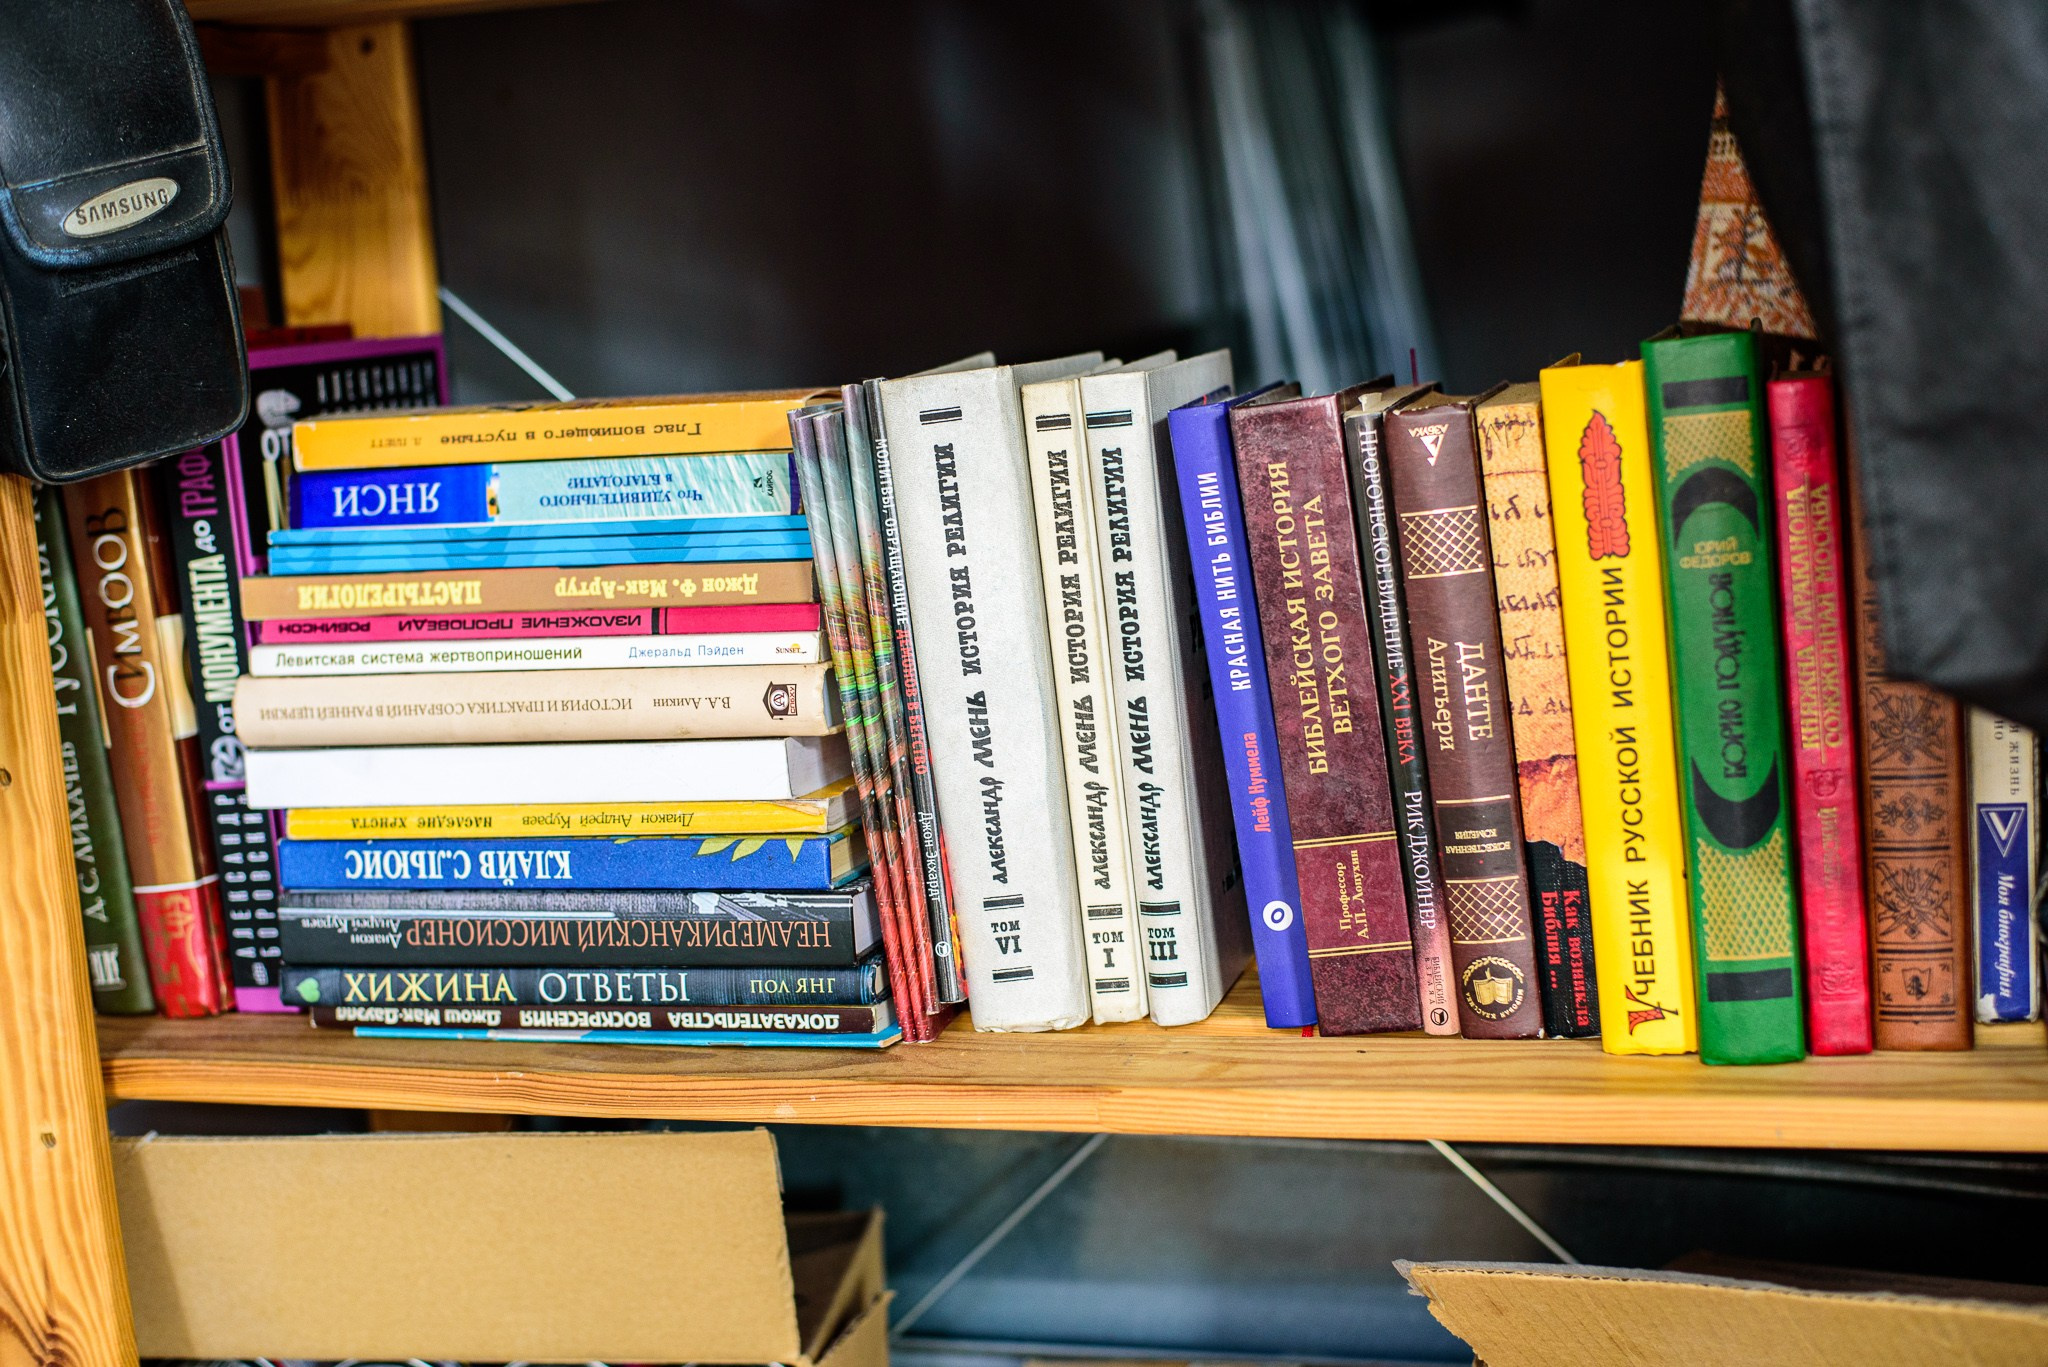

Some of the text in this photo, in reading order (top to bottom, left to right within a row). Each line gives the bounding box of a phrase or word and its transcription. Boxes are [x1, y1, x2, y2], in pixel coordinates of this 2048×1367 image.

[75, 187, 169, 226] SAMSUNG
[441, 431, 517, 445] пустыне
[525, 431, 535, 440] в
[544, 425, 645, 439] вопиющего
[654, 423, 702, 436] Глас
[1408, 424, 1449, 437] АЗБУКА
[539, 489, 671, 507] УДИВИТЕЛЬНОГО
[567, 474, 661, 489] БЛАГОДАТИ?
[333, 482, 441, 517] ЯНСИ
[933, 443, 967, 558] РЕЛИГИИ
[1047, 449, 1079, 566] РЕЛИГИИ
[1102, 447, 1134, 563] РЕЛИГИИ
[1358, 428, 1392, 577] ПРОРОЧЕСКОЕ
[1693, 535, 1738, 555] ЮРИЙ
[1810, 482, 1834, 582] МОСКВА
[298, 573, 758, 610] Джон Ф. Мак-Артур ПАСТЫРЕЛОГИЯ
[188, 553, 240, 703] МОНУМЕНТА
[278, 615, 642, 634] ИЗЛОЖЕНИЕ ПРОПОВЕДИ РОБИНСОН
[949, 566, 982, 677] ИСТОРИЯ
[1060, 573, 1091, 684] ИСТОРИЯ
[1115, 570, 1146, 682] ИСТОРИЯ
[1267, 461, 1329, 775] БИБЛЕЙСКАЯ ИСТОРИЯ
[1303, 495, 1353, 734] ВЕТХОГО ЗАВЕТА
[1376, 579, 1405, 670] ВИДЕНИЕ
[1786, 484, 1821, 751] КНЯЖНА ТАРАКАНОВА
[1708, 572, 1746, 692] ГОДУНОВ
[276, 644, 744, 668] Левитская система жертвоприношений Джеральд Пэйден
[1197, 471, 1272, 833] Лейф Нуммела КРАСНАЯ НИТЬ БИБЛИИ
[874, 438, 942, 902] МОЛИТВЫ, ОБРАЩАЮЩИЕ ДЕМОНОВ В БЕГСТВО Джон Экхардт
[467, 700, 544, 716] ПРАКТИКА
[546, 700, 558, 712] И
[561, 698, 632, 713] ИСТОРИЯ
[1427, 637, 1455, 751] Алигьери
[1454, 641, 1493, 741] ДАНТЕ
[260, 706, 315, 721] ЦЕРКВИ
[317, 705, 374, 720] РАННЕЙ
[376, 707, 385, 717] В
[387, 703, 465, 718] СОБРАНИЙ
[966, 691, 995, 768] МЕНЬ
[1072, 694, 1100, 775] МЕНЬ
[1127, 695, 1155, 775] МЕНЬ
[1395, 716, 1415, 765] ВЕКА
[1404, 790, 1425, 832] РИК
[1601, 567, 1678, 1036] УЧЕБНИК РУССКОЙ ИСТОРИИ
[522, 815, 571, 829] Кураев
[580, 813, 632, 826] Андрей
[641, 812, 694, 827] Диакон
[1454, 828, 1497, 840] КОМЕДИЯ
[1445, 841, 1511, 855] БОЖЕСТВЕННАЯ
[214, 794, 257, 959] АЛЕКСАНДР
[478, 850, 572, 886] КЛАЙВ
[1406, 833, 1436, 930] ДЖОЙНЕР
[1336, 861, 1352, 931] Профессор
[1350, 849, 1370, 940] А.П. Лопухин
[301, 917, 401, 933] Андрей Кураев
[350, 934, 402, 948] Диакон
[406, 919, 833, 952] НЕАМЕРИКАНСКИЙ МИССИОНЕР
[991, 920, 1021, 933] ТОМ
[1092, 931, 1125, 944] ТОМ
[1147, 927, 1176, 939] ТОМ
[1541, 890, 1562, 966] Библия
[1993, 871, 2016, 998] Моя биография
[994, 935, 1023, 955] VI
[1103, 947, 1116, 968] I
[1149, 940, 1179, 962] III
[1563, 890, 1589, 1027] Как возникла
[344, 972, 835, 1003] ХИЖИНА ОТВЕТЫ ПОЛ ЯНГ
[1431, 956, 1446, 1005] БИБЛЕЙСКИЙ
[444, 1008, 501, 1026] Джош
[520, 1009, 652, 1029] ВОСКРЕСЕНИЯ
[667, 1011, 840, 1030] ДОКАЗАТЕЛЬСТВА
[1499, 988, 1525, 1020] МИРОВАЯ
